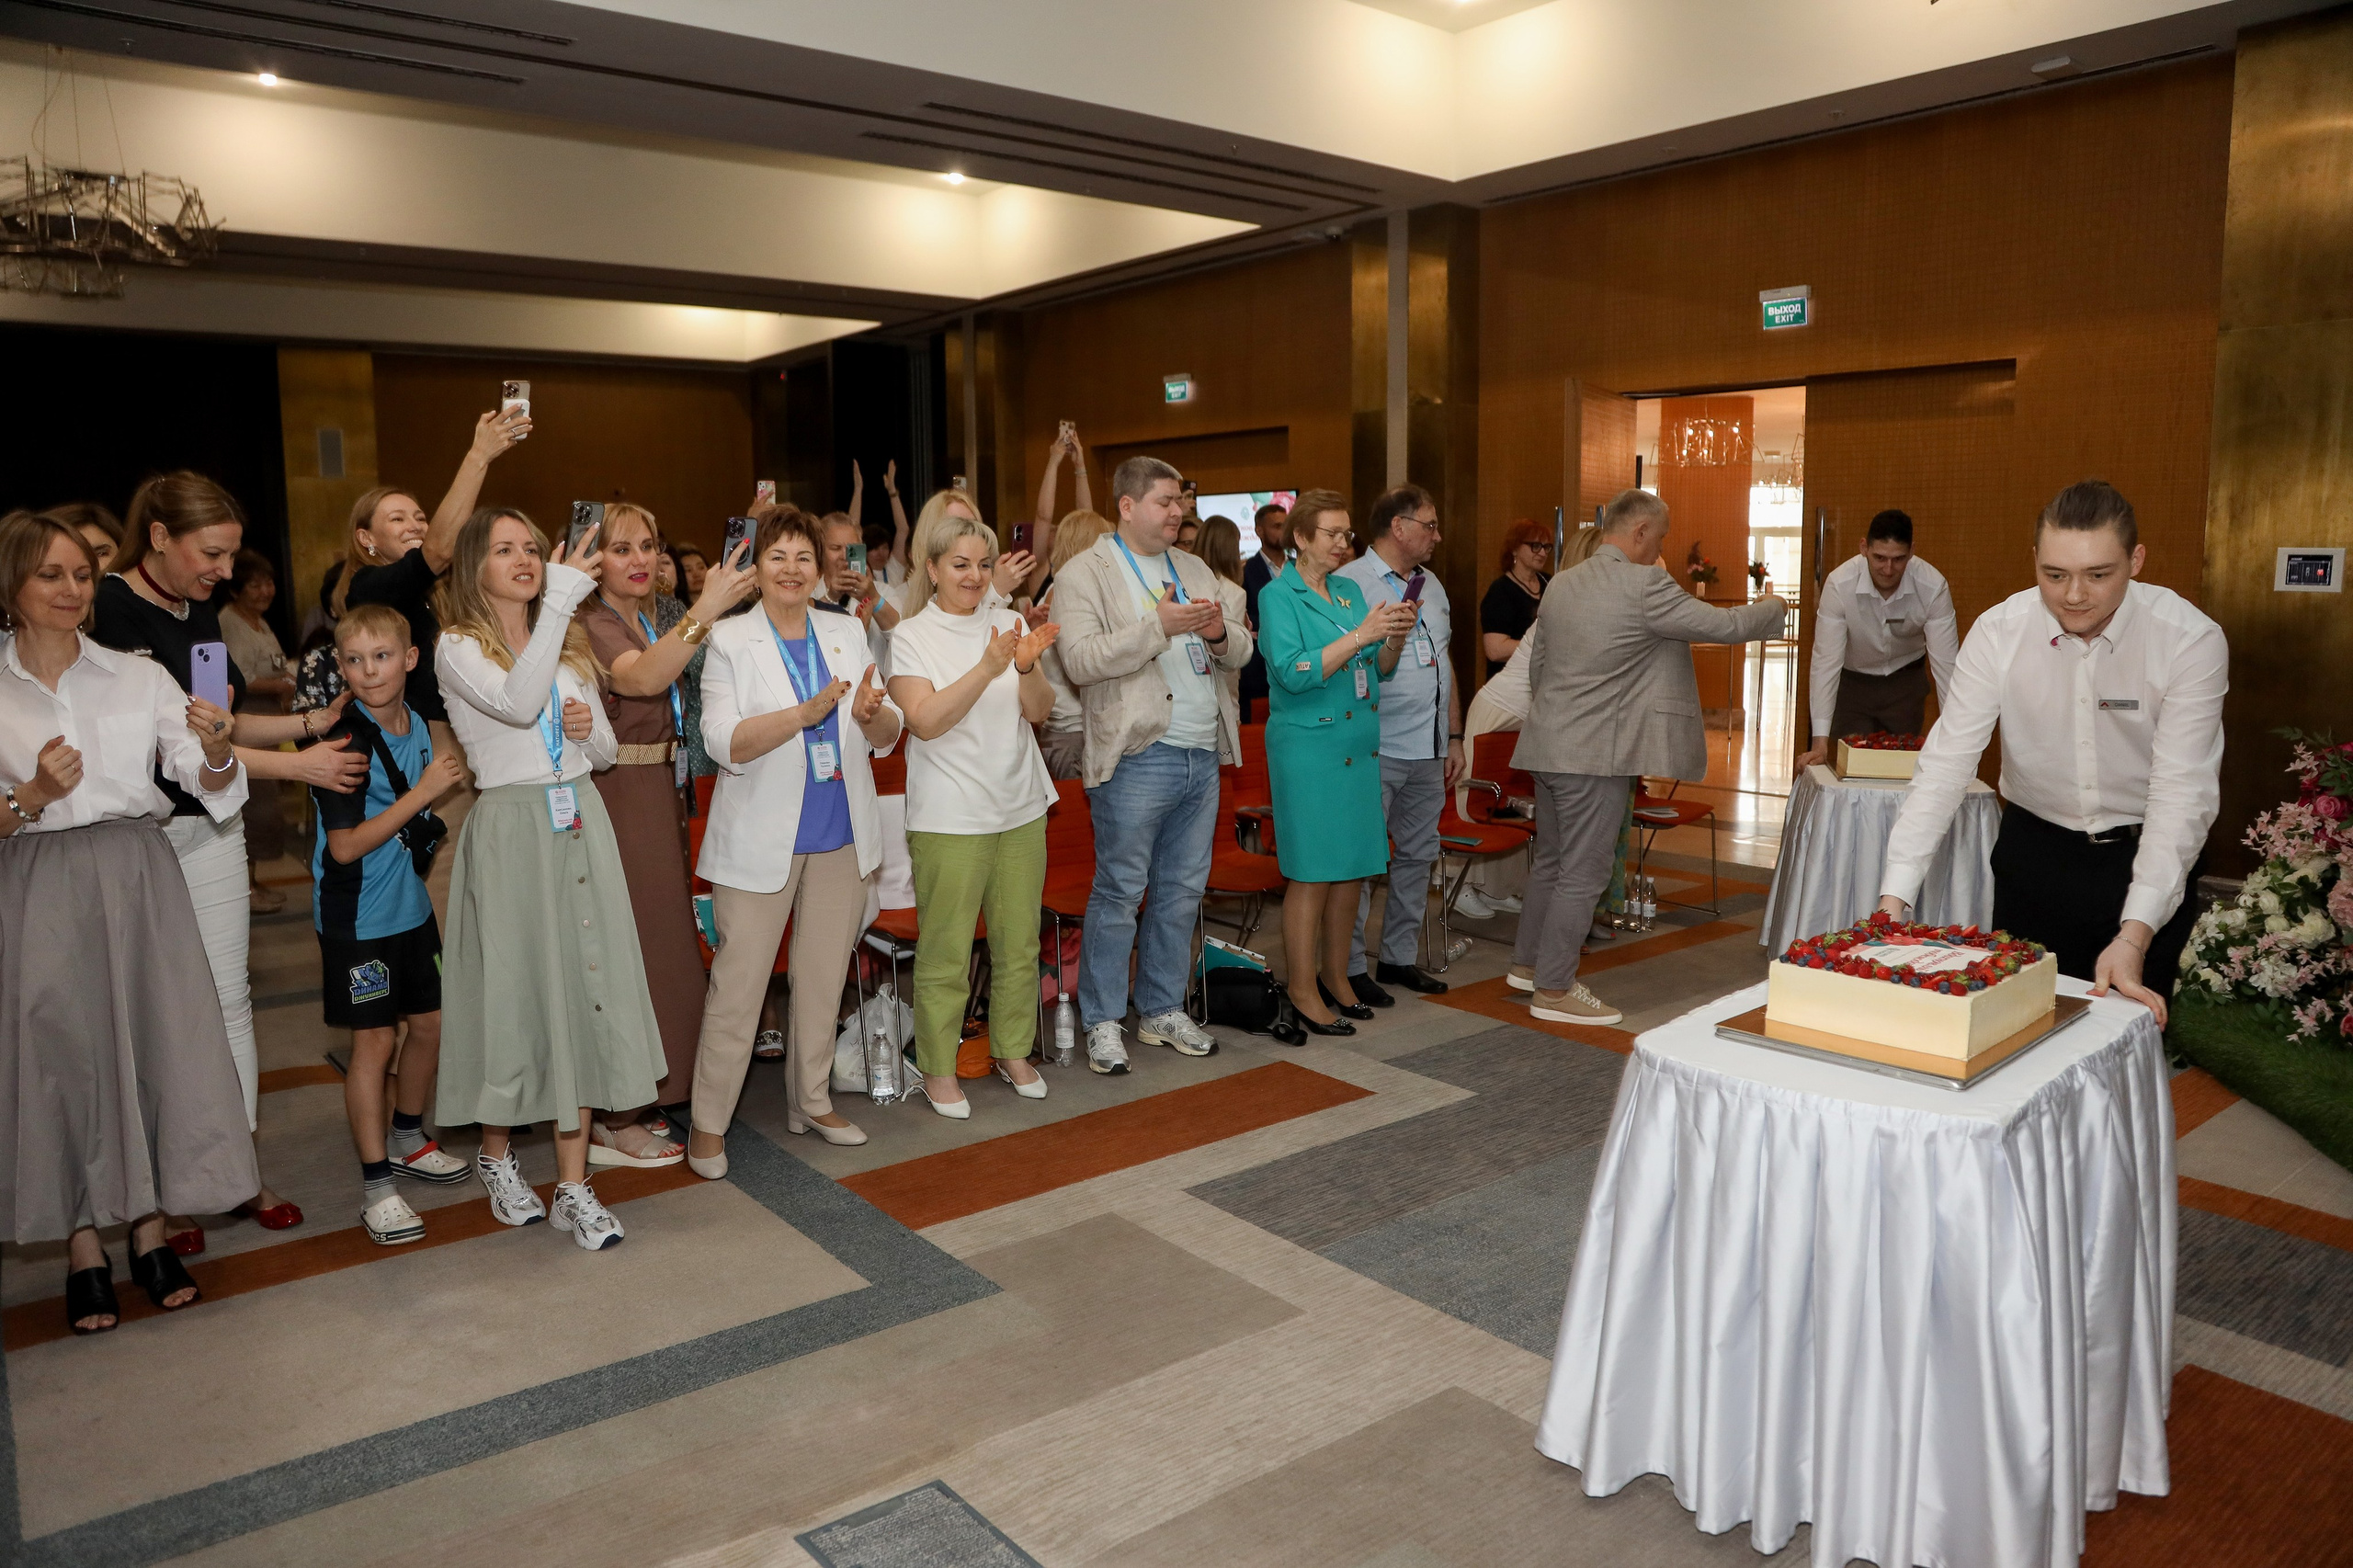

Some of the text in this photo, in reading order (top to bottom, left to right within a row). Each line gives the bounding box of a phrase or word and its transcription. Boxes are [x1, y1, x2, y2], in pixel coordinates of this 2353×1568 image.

[1768, 303, 1802, 316] ВЫХОД
[1775, 313, 1794, 324] EXIT
[353, 982, 388, 995] ДИНАМО
